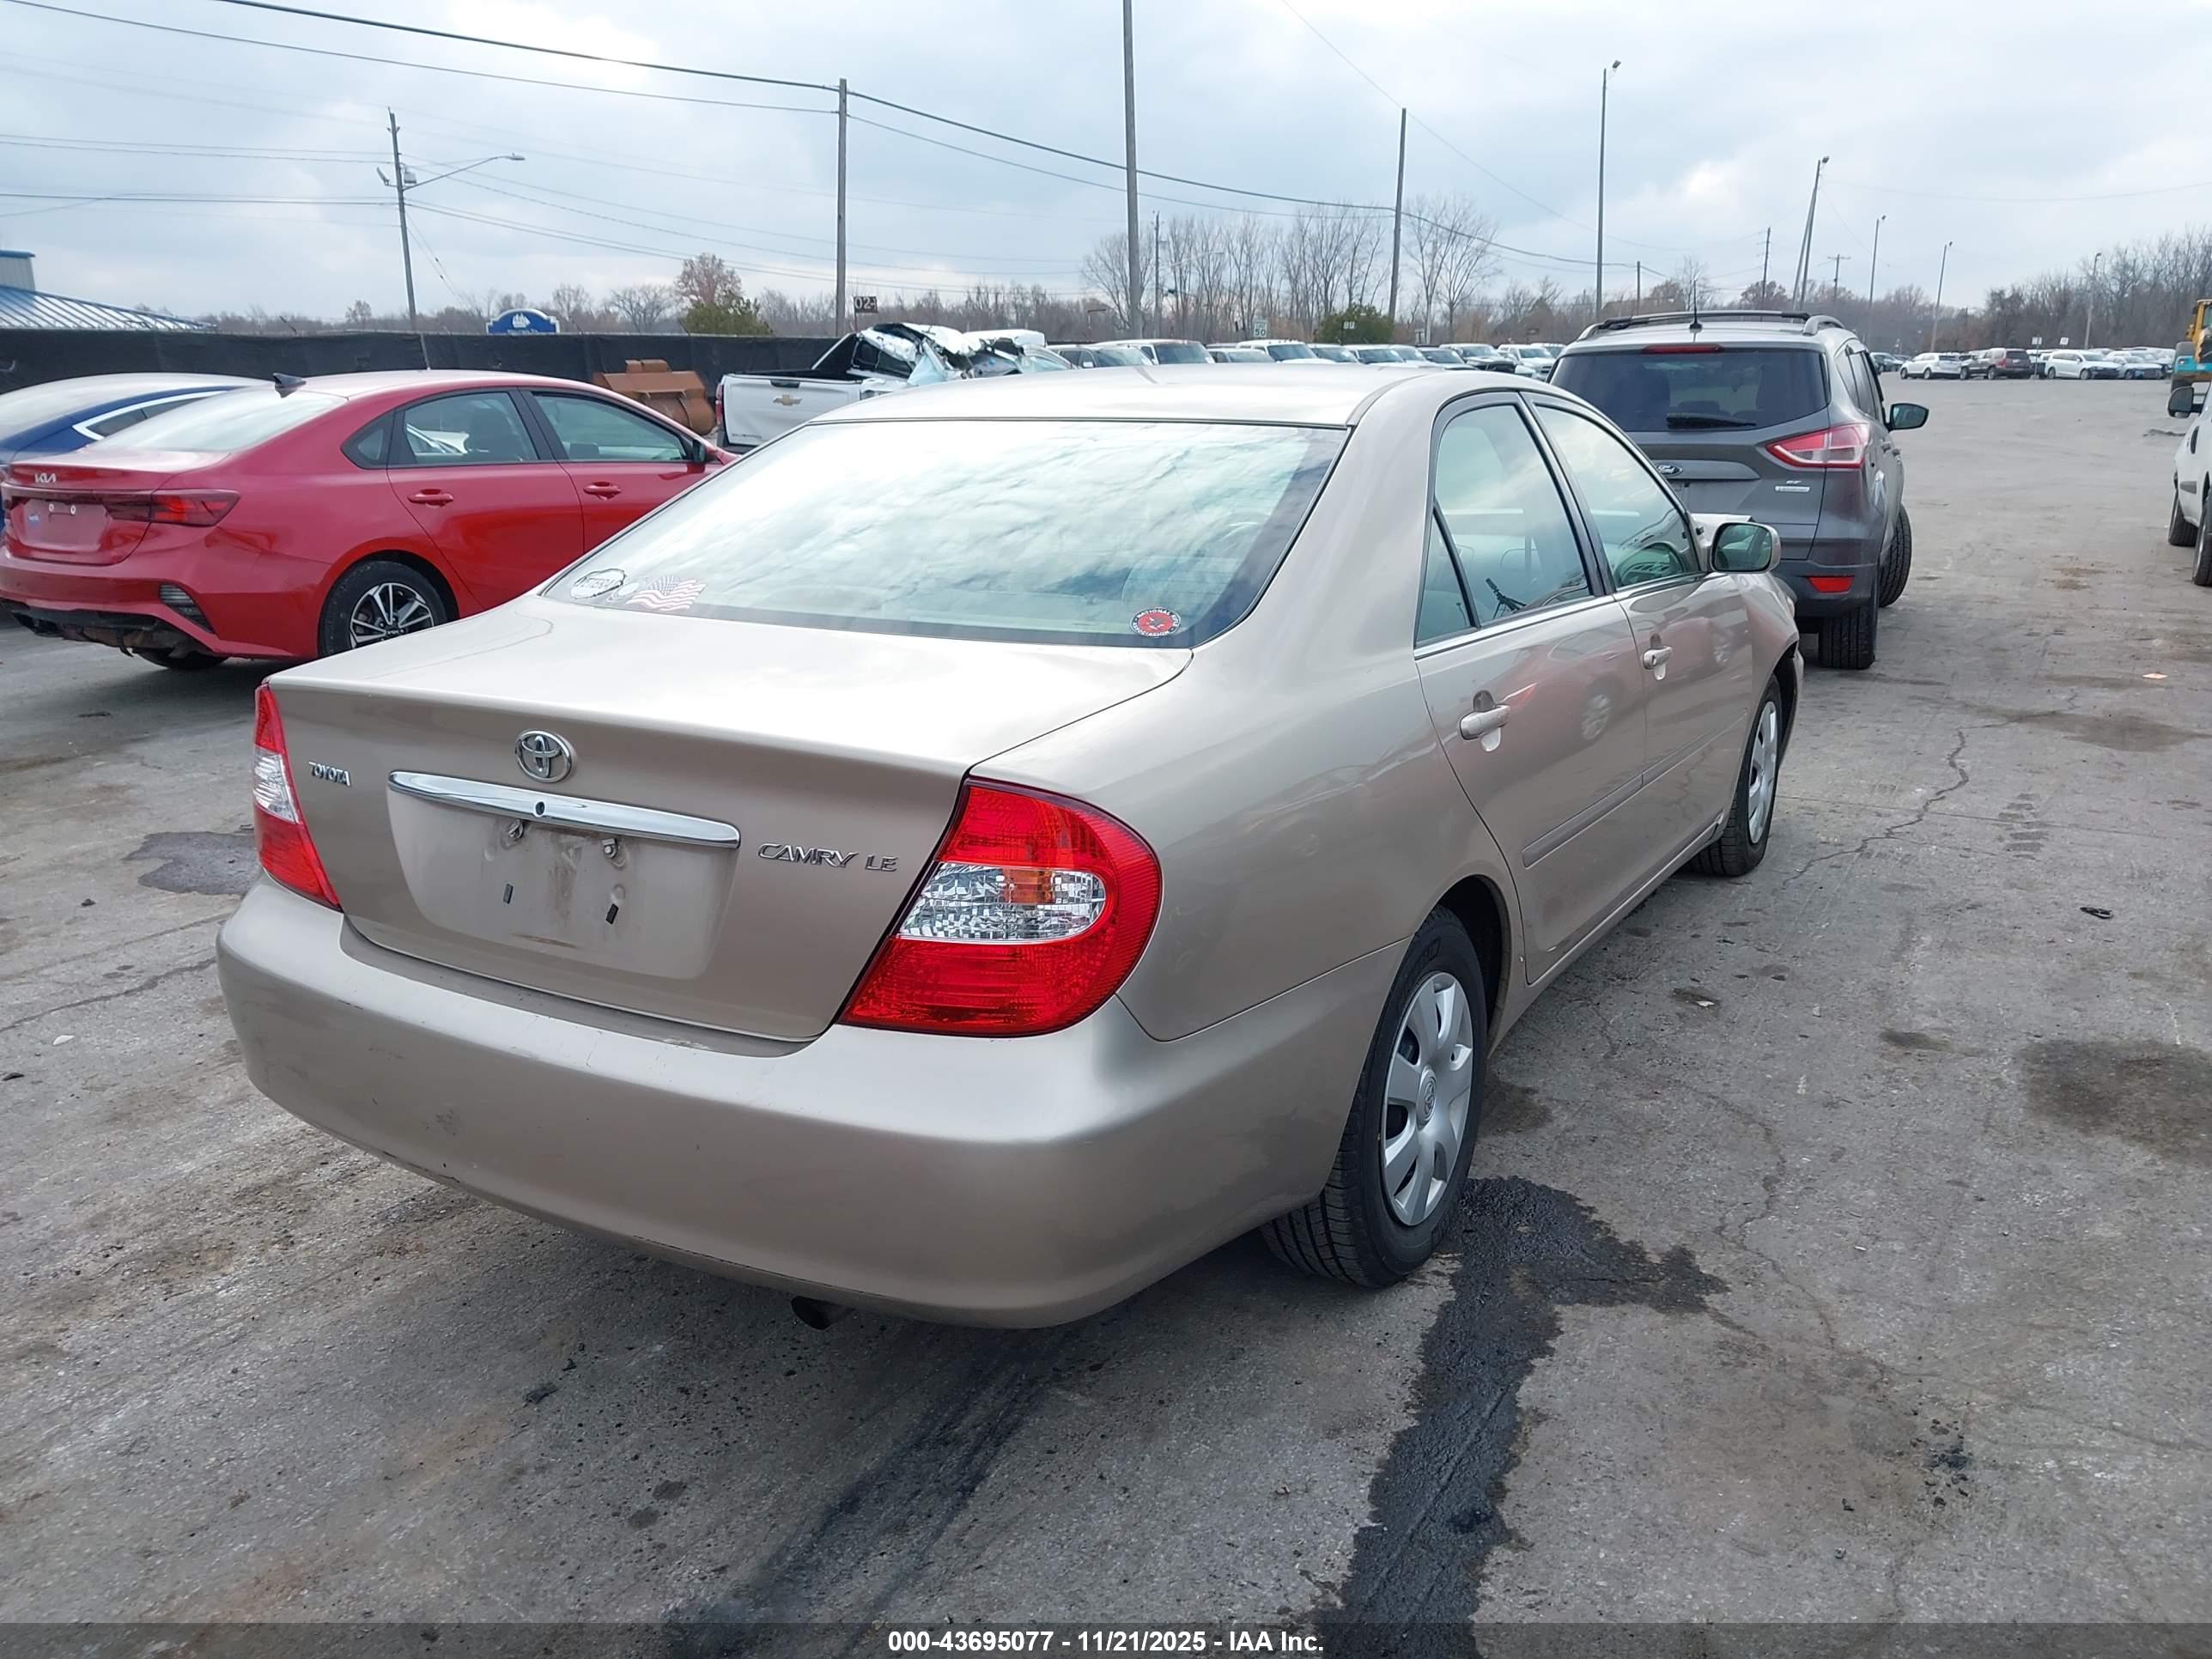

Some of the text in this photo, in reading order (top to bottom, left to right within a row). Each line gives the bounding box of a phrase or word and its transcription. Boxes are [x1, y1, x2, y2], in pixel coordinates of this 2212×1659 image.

[308, 761, 350, 787] TOYOTA
[757, 842, 899, 872] CAMRY LE
